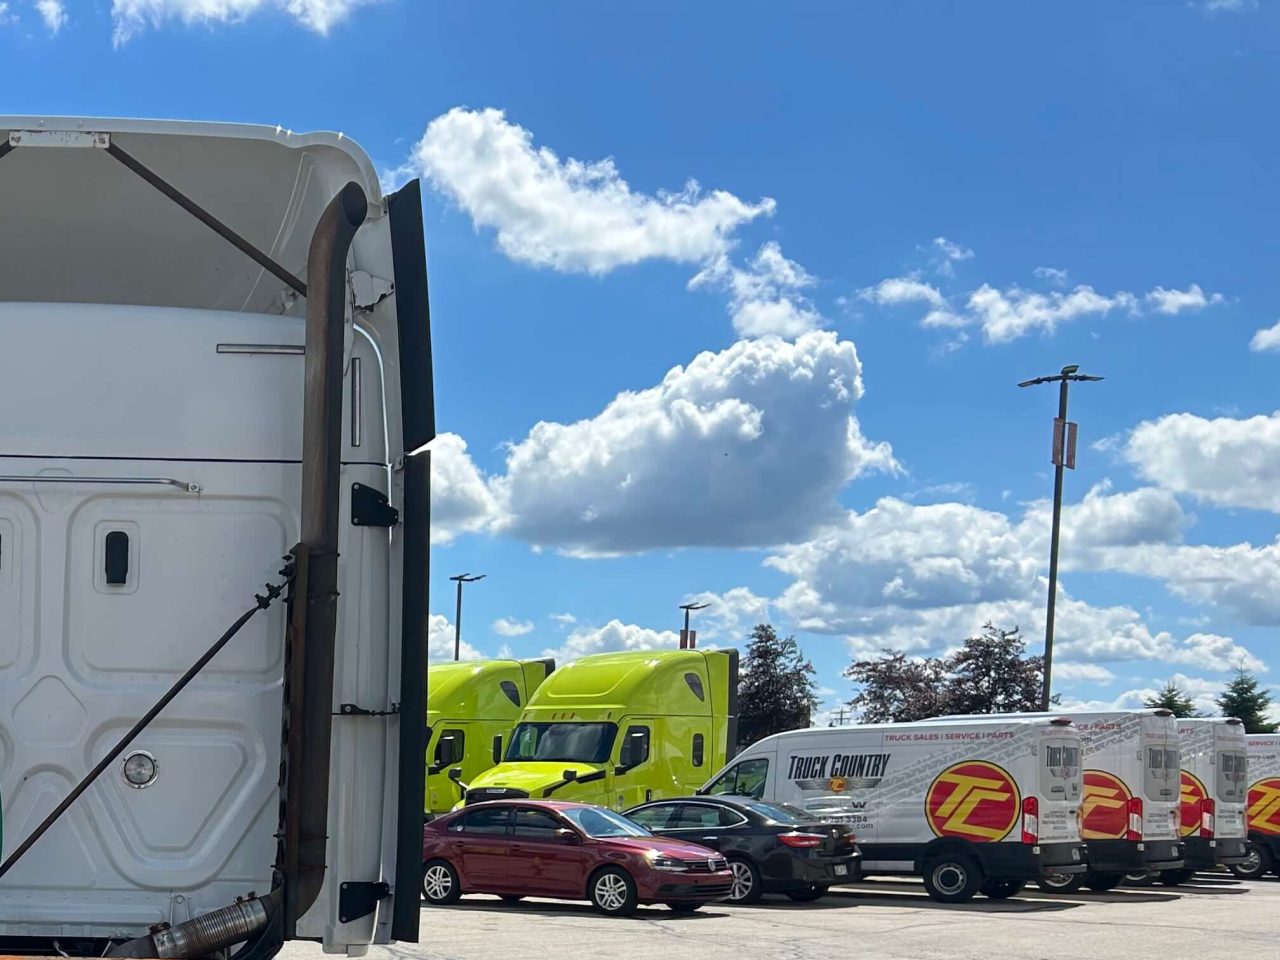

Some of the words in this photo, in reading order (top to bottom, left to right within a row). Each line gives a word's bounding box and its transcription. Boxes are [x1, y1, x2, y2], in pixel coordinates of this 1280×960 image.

[945, 732, 980, 740] SERVICE
[986, 731, 1016, 739] PARTS
[788, 756, 830, 779] TRUCK
[829, 754, 891, 778] COUNTRY
